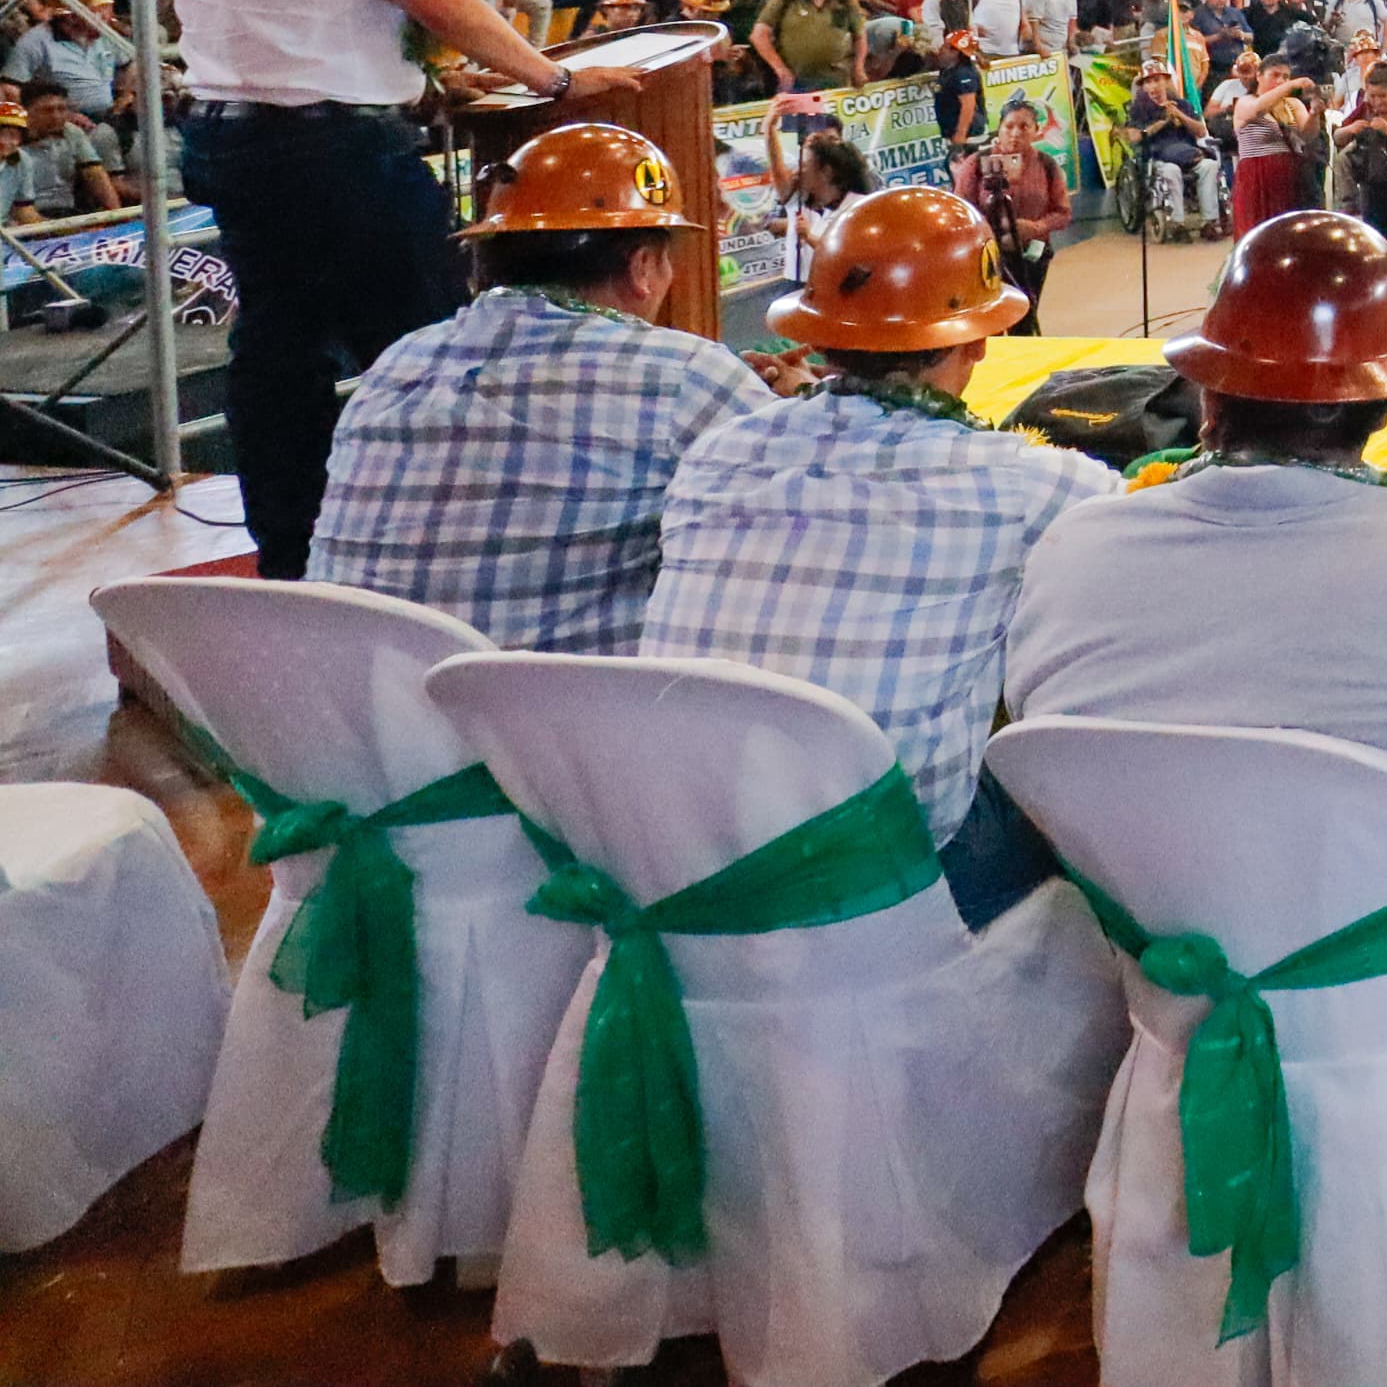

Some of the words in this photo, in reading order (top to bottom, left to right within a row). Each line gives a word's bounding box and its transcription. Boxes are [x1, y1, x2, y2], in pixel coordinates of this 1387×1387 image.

[842, 84, 936, 117] COOPERA
[986, 60, 1059, 87] MINERAS
[890, 106, 937, 130] RODE
[93, 237, 238, 302] MIERA
